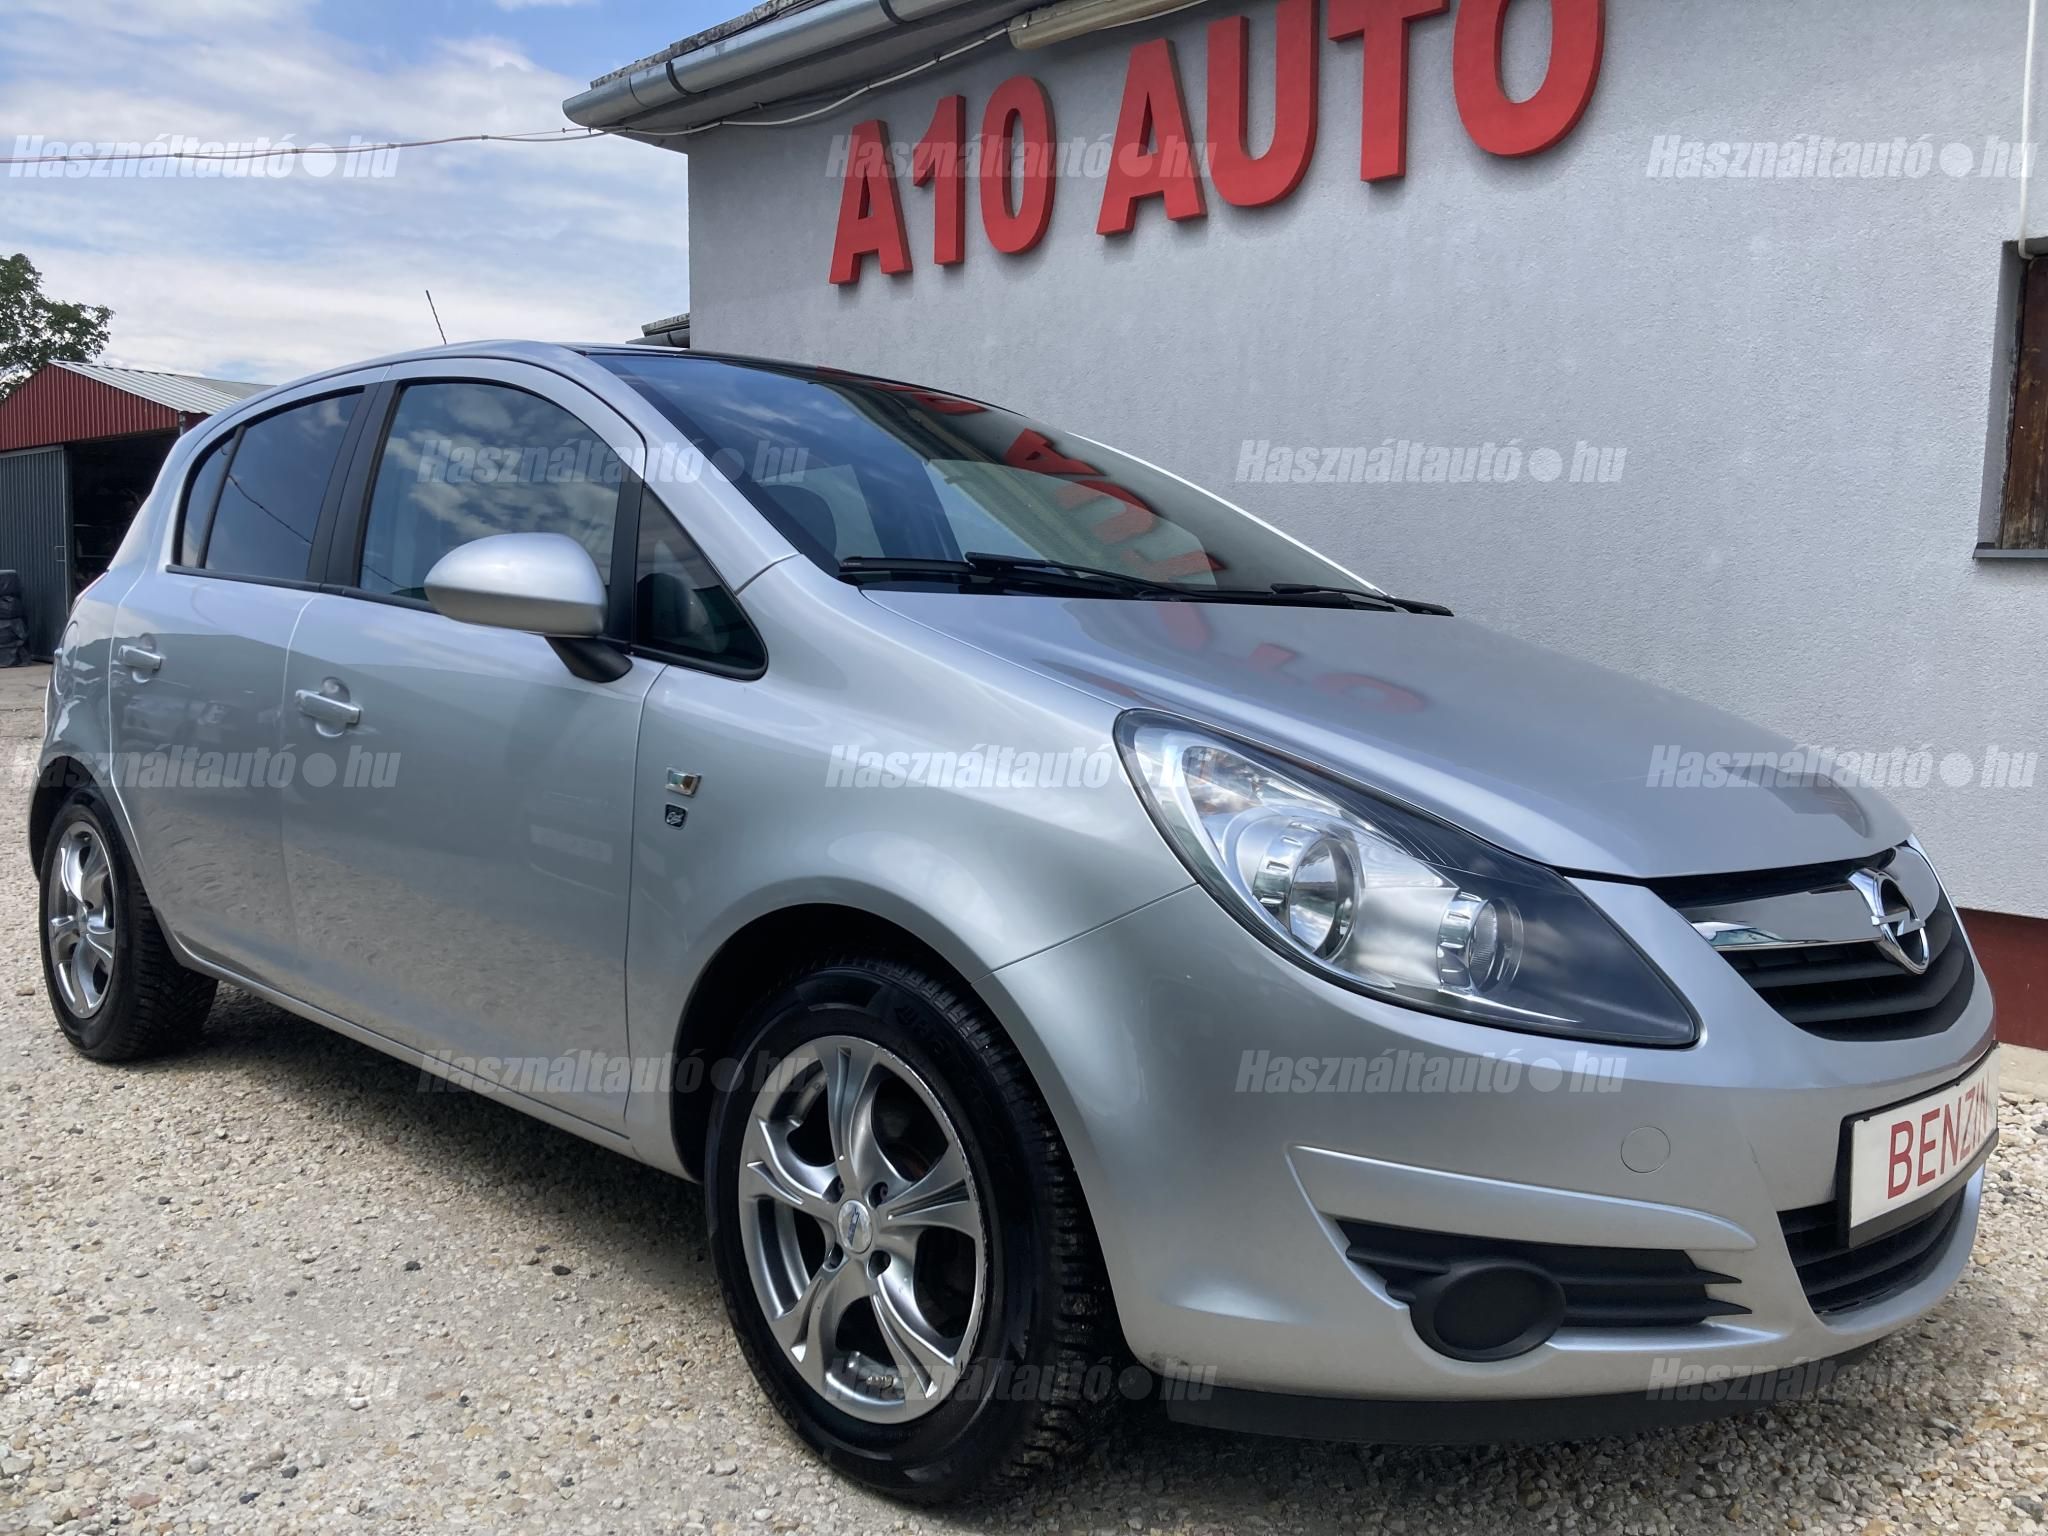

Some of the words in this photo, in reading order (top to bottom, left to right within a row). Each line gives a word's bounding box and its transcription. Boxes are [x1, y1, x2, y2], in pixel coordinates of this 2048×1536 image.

[828, 75, 1057, 285] A10
[1096, 0, 1606, 237] AUTO
[1887, 1075, 1990, 1199] BENZIN
